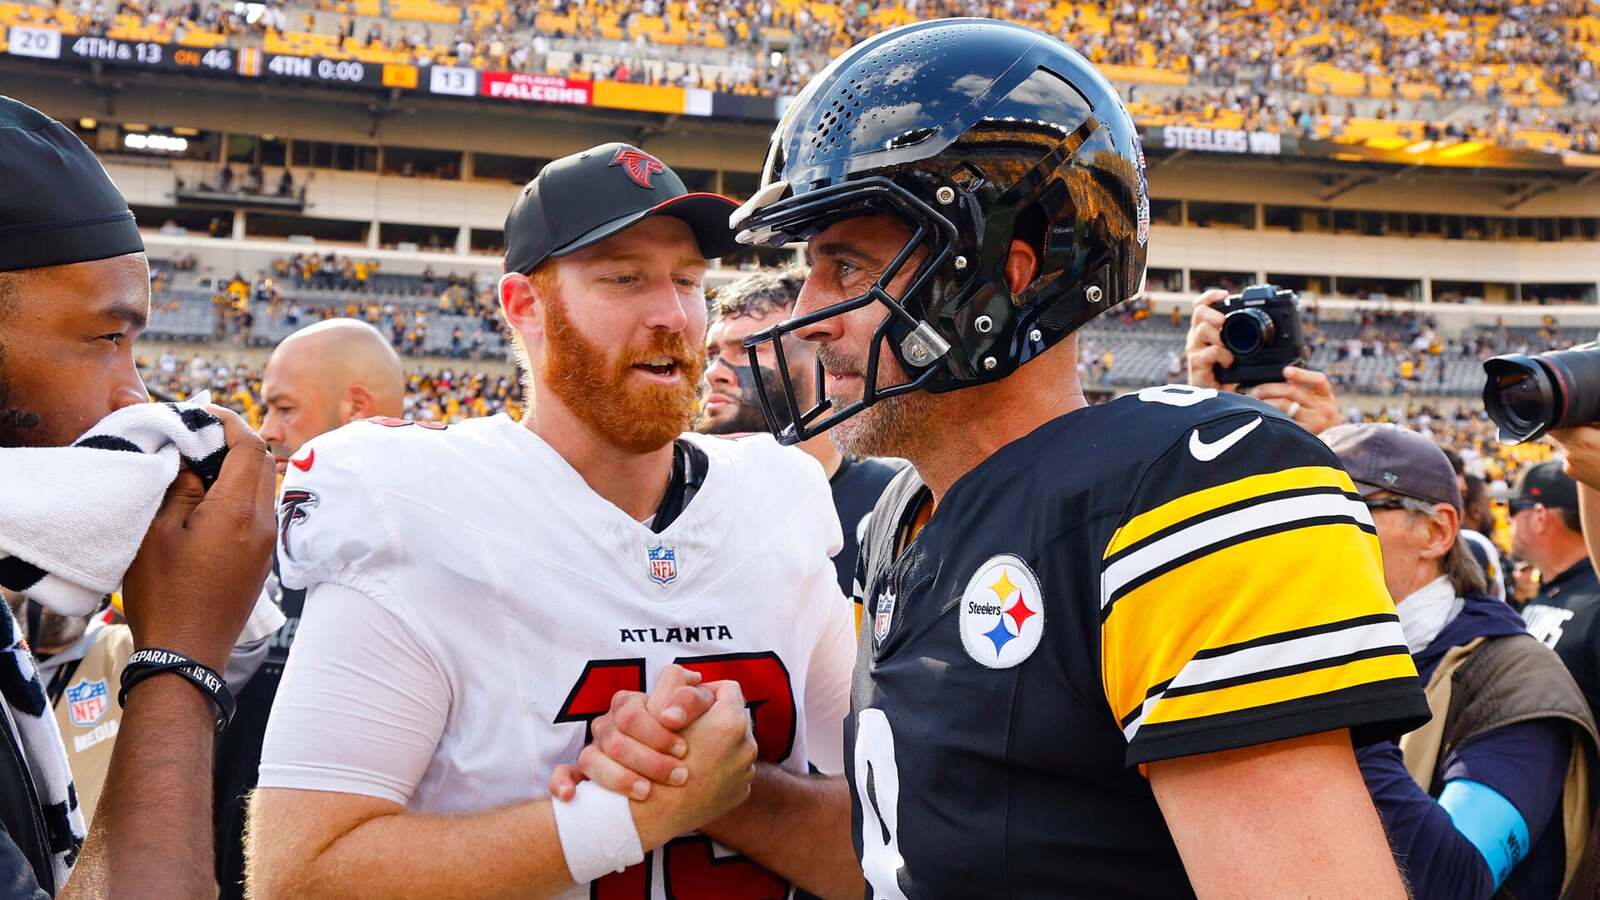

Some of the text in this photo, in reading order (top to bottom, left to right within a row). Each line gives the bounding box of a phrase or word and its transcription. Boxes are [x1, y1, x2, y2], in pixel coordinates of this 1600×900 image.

[20, 31, 49, 50] 20
[135, 42, 162, 64] 13
[202, 49, 231, 70] 46
[268, 55, 364, 82] 4TH 0:00
[490, 81, 588, 105] FALCONS
[1163, 125, 1247, 153] STEELERS
[652, 560, 675, 578] NFL
[968, 601, 1002, 616] Steelers
[619, 625, 733, 643] ATLANTA
[193, 665, 204, 681] IS
[204, 673, 222, 694] KEY
[71, 697, 106, 721] NFL
